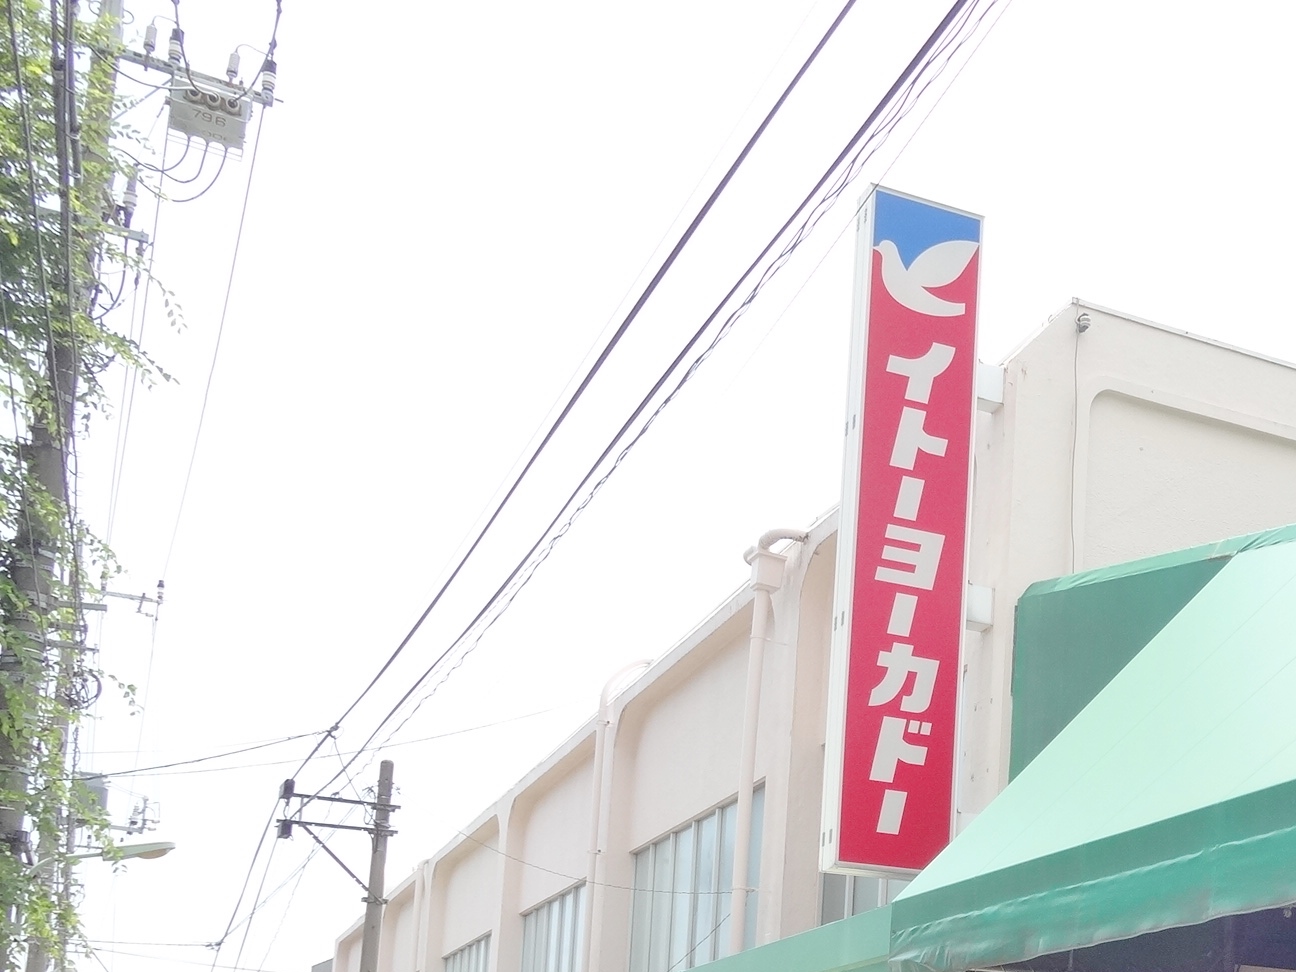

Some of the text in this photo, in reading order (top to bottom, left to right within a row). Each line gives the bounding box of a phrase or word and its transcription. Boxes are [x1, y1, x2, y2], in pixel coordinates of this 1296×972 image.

[192, 108, 227, 128] 796
[868, 342, 956, 835] イトーヨーカドー
